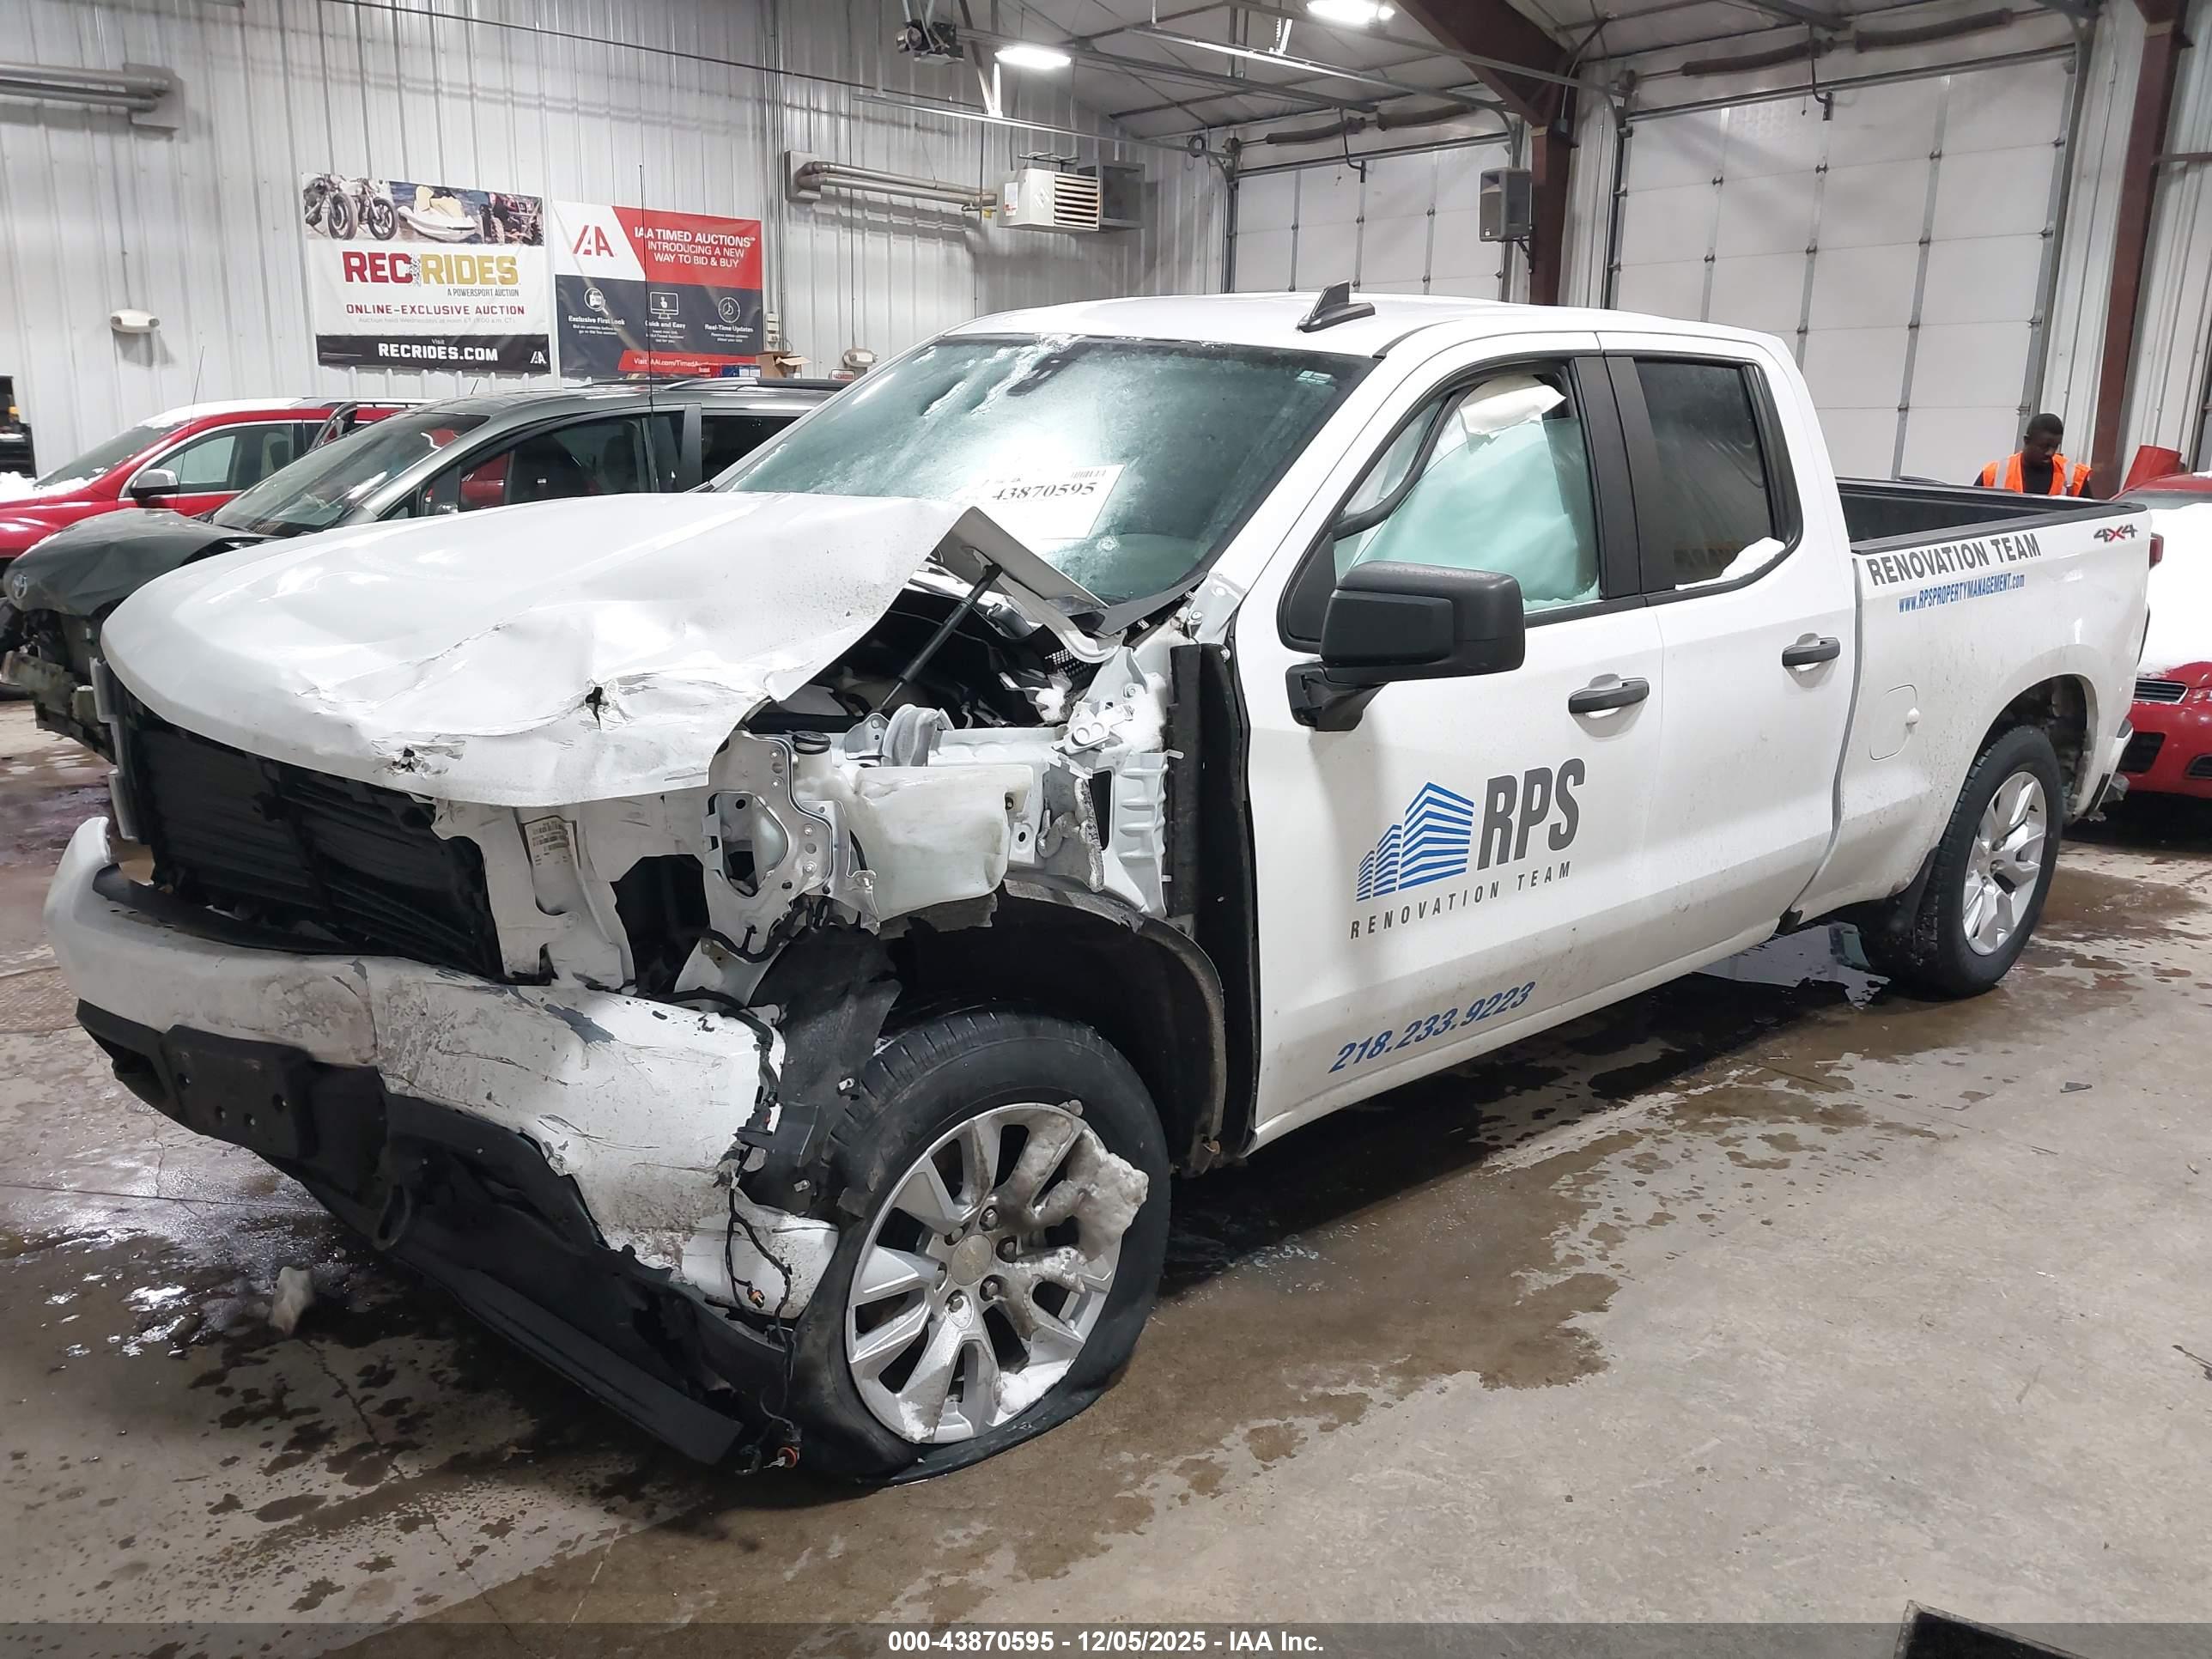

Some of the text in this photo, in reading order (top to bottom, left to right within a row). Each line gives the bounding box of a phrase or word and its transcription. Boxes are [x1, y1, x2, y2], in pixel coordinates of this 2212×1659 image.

[655, 228, 692, 241] TIMED
[647, 240, 744, 258] INTRODUCING A NEW
[653, 252, 739, 268] WAY TO BID & BUY
[420, 254, 520, 285] RIDES
[453, 289, 494, 297] POWERSPORT
[346, 303, 526, 316] ONLINE-EXCLUSIVE AUCTION
[568, 315, 597, 324] Exclusive
[705, 324, 754, 333] Real-Time Updates
[378, 343, 499, 362] RECRIDES.COM
[992, 482, 1097, 501] 43870595
[1866, 532, 2041, 586] RENOVATION TEAM
[1476, 757, 1586, 872] RPS
[1350, 860, 1571, 939] RENOVATION TEAM
[1328, 981, 1536, 1073] 218.233.9223
